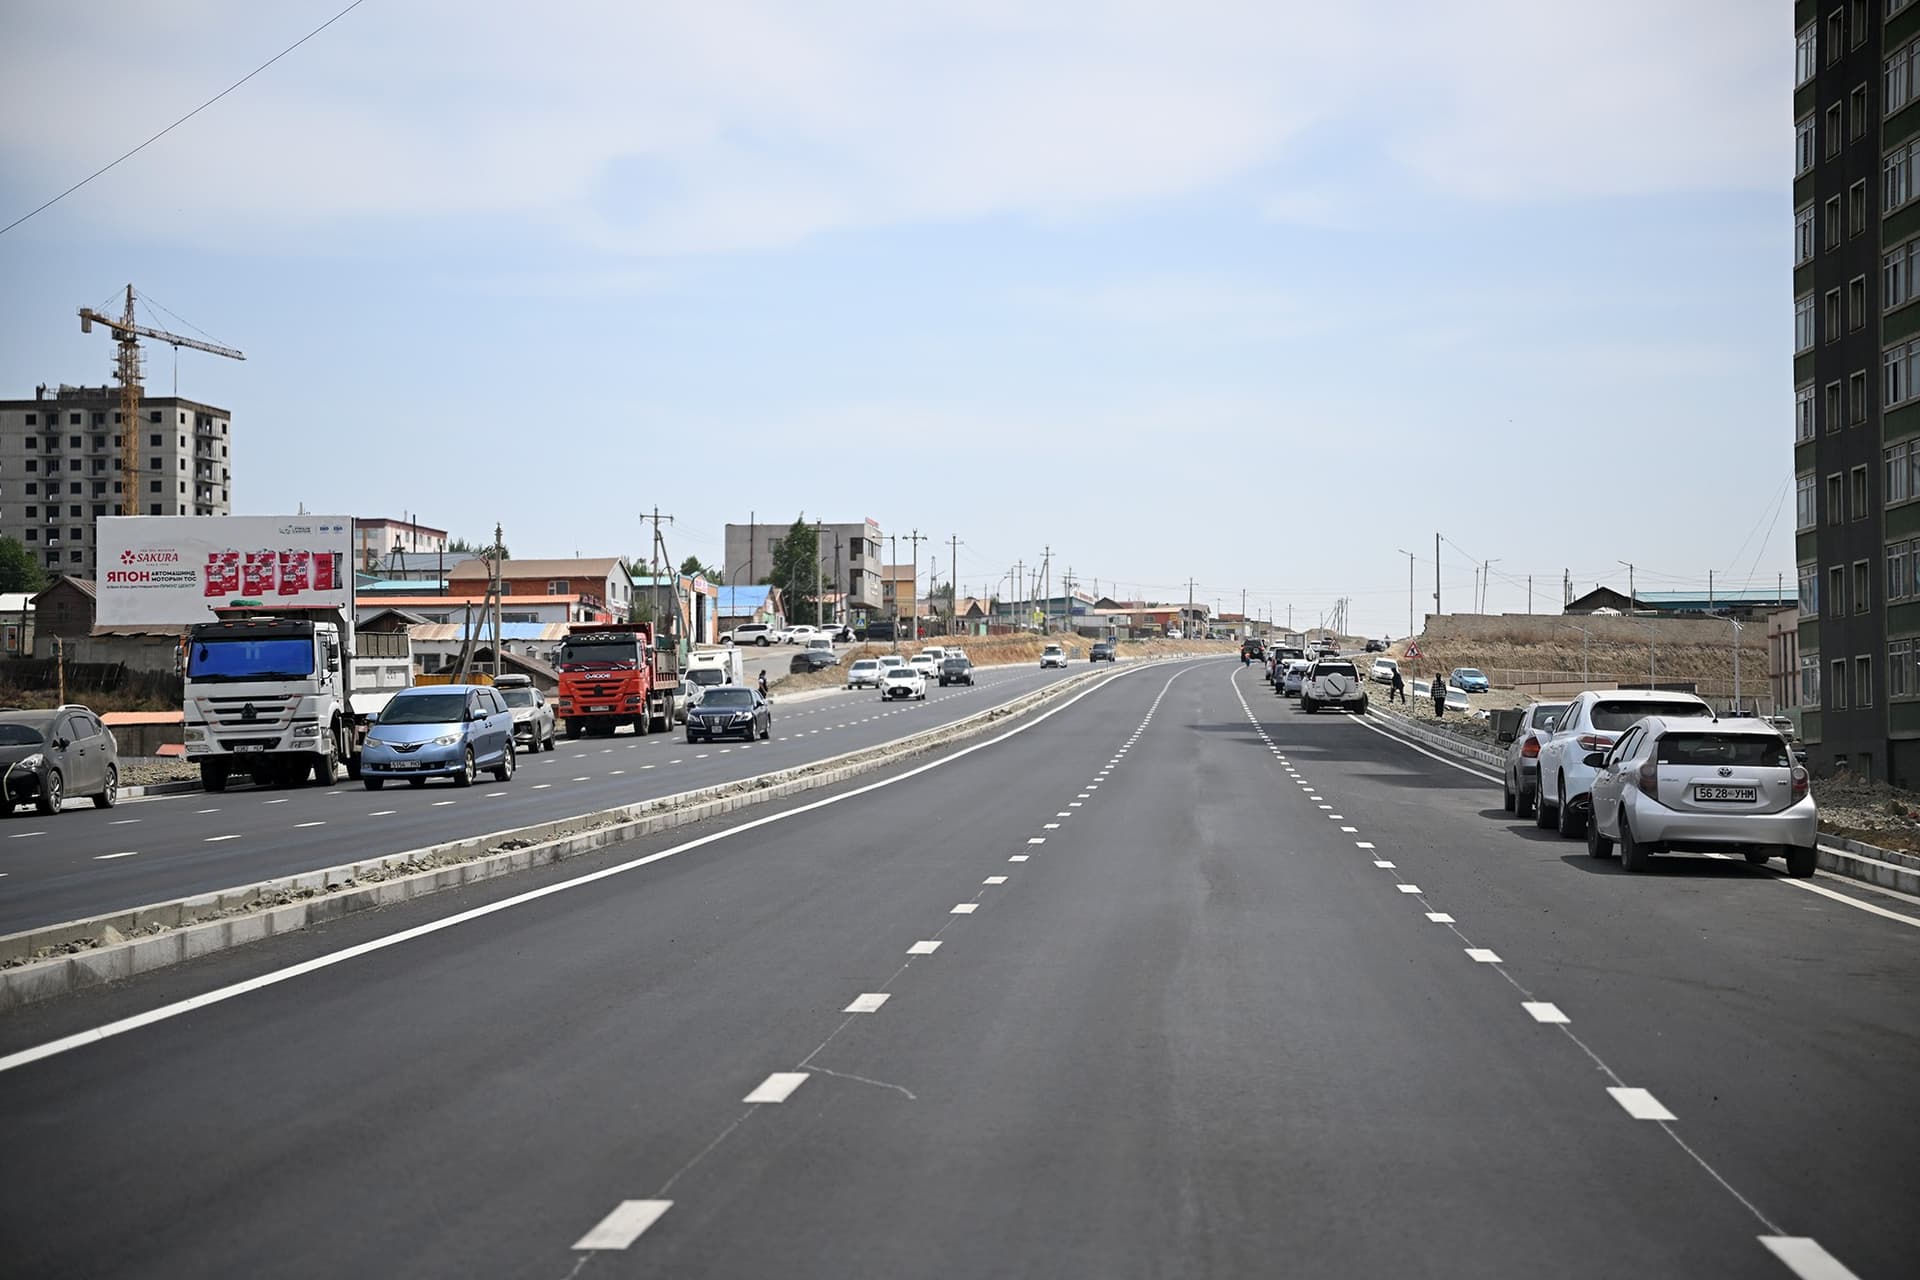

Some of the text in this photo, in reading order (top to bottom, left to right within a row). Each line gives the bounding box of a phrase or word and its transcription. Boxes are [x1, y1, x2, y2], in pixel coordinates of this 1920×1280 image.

[136, 553, 179, 562] SAKURA
[107, 571, 150, 582] ЯПОН
[1734, 788, 1754, 799] УНМ
